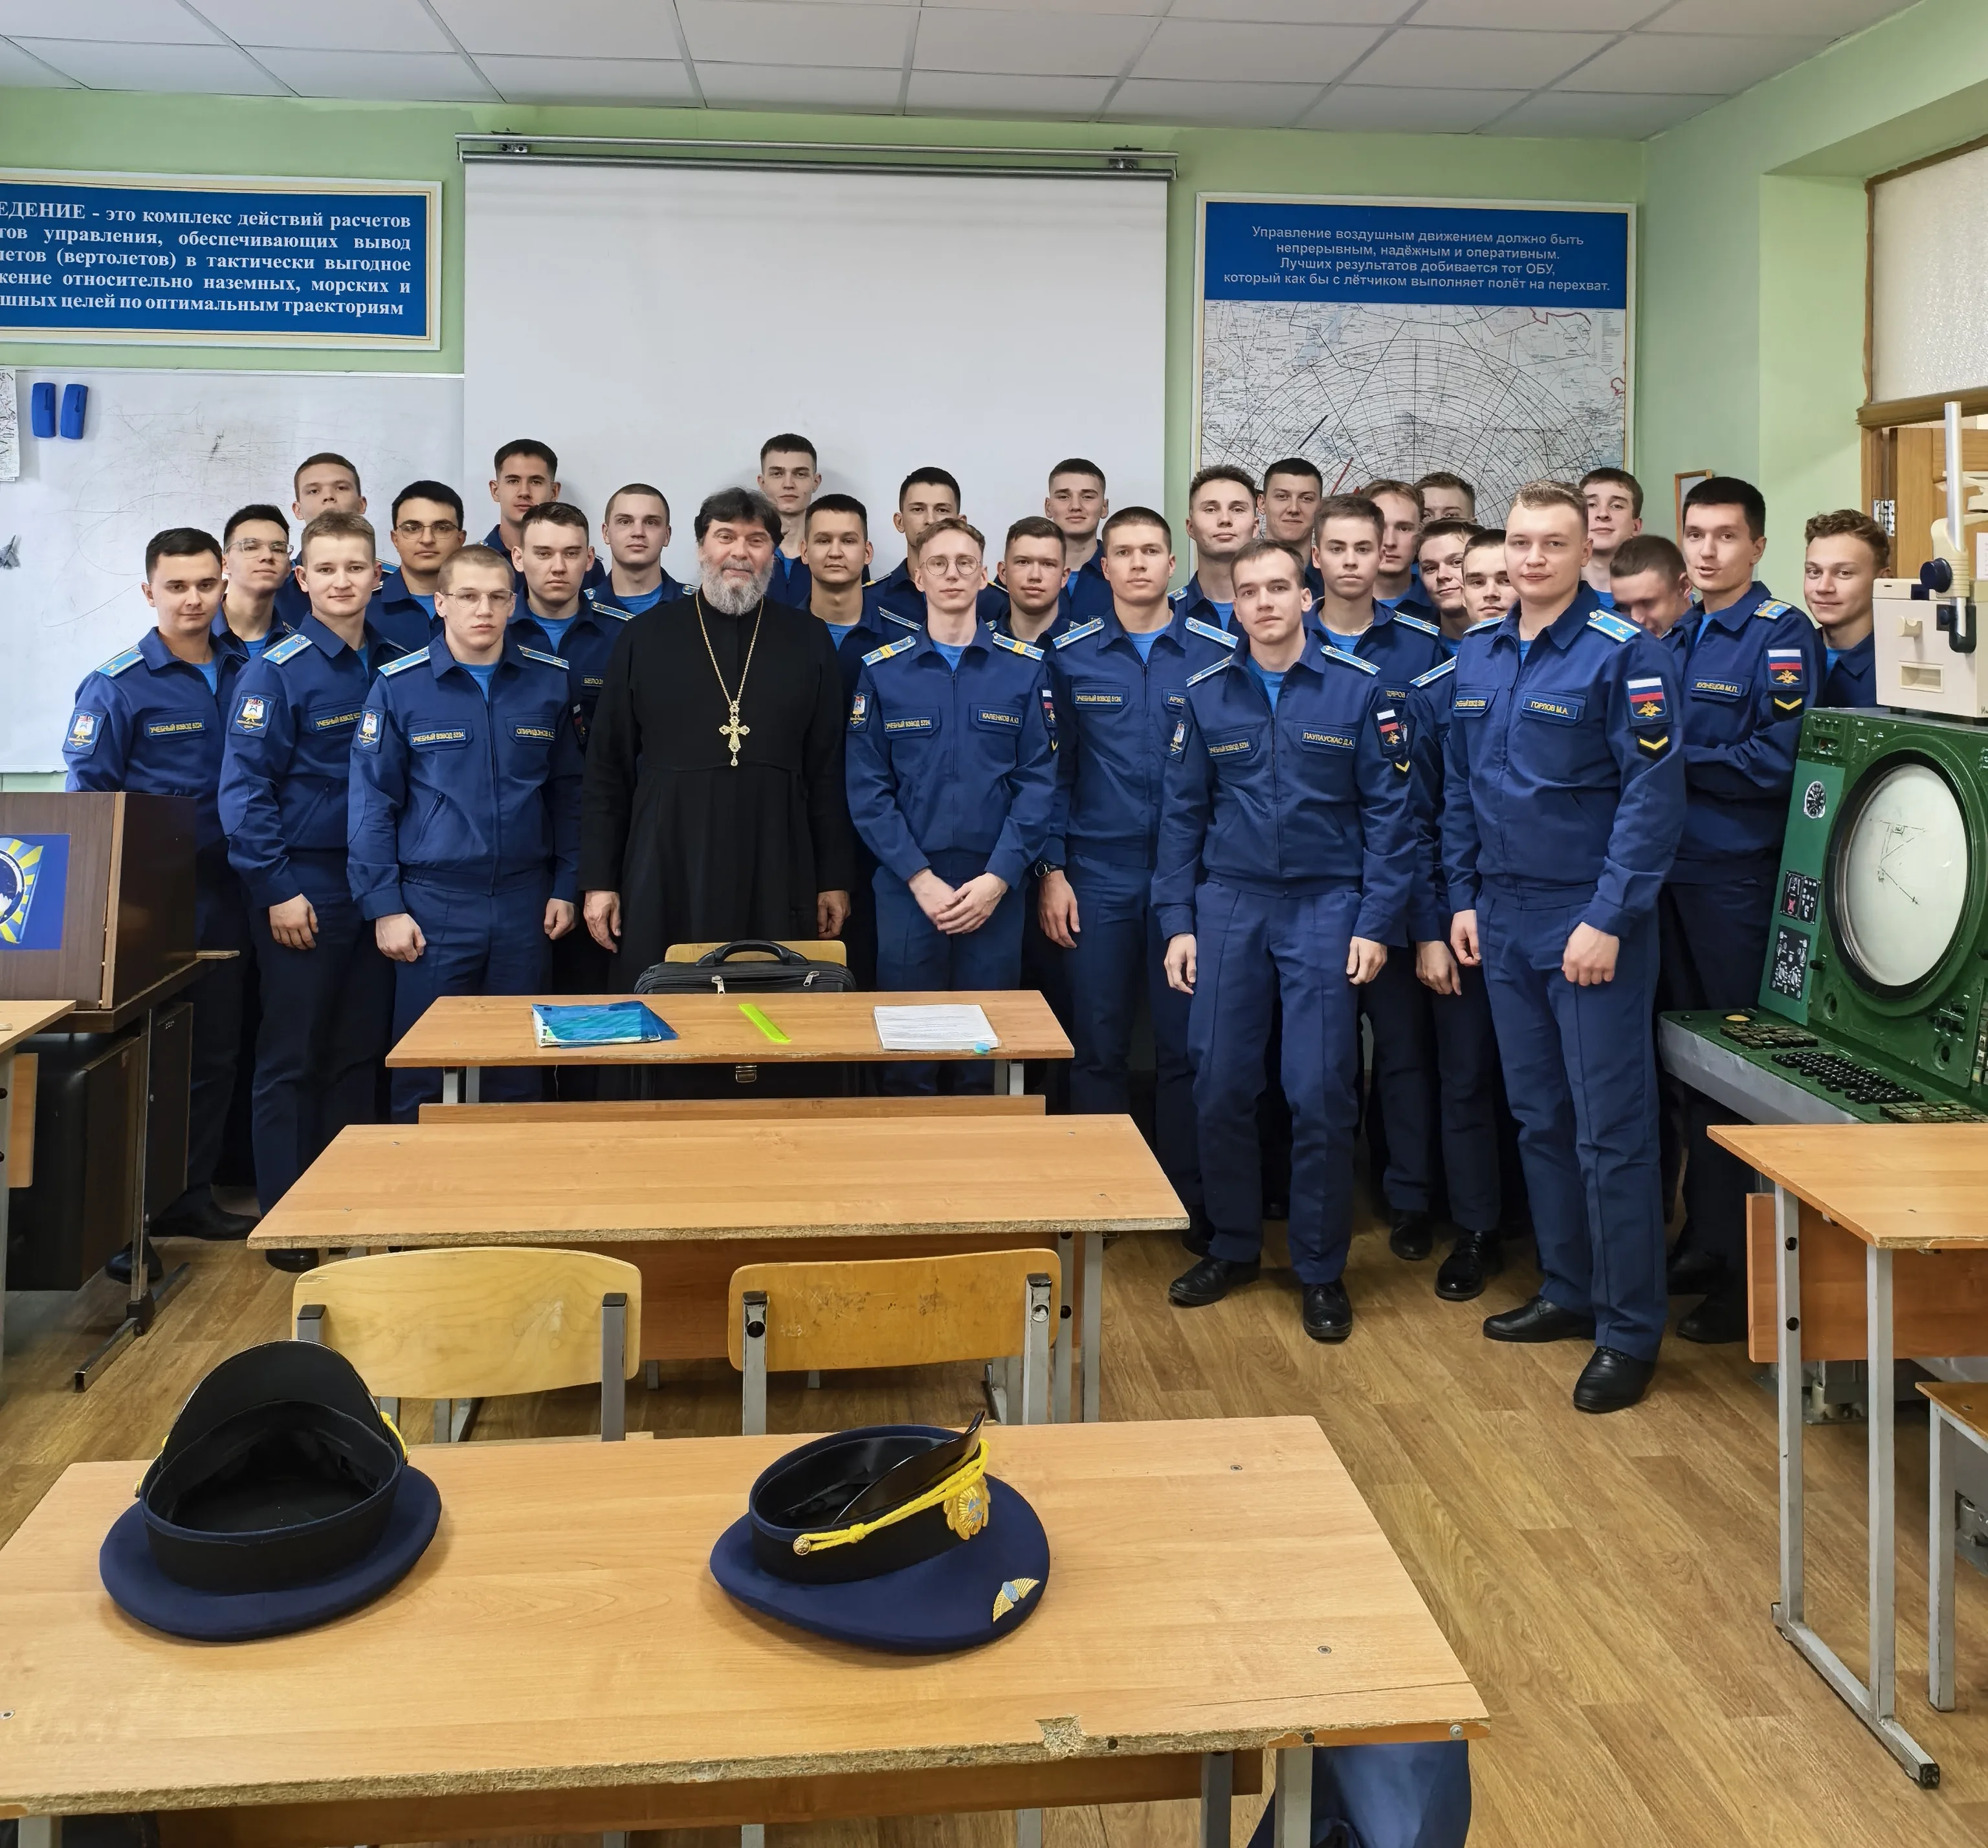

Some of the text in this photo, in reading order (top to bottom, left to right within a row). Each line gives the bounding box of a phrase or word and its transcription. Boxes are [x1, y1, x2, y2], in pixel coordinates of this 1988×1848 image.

[106, 210, 136, 222] это
[142, 211, 232, 225] комплекс
[237, 211, 323, 226] действий
[330, 215, 411, 230] расчетов
[43, 228, 163, 248] управления,
[178, 230, 338, 249] обеспечивающих
[354, 237, 411, 252] вывод
[1252, 226, 1584, 245] Управление воздушным движением должно быть
[56, 248, 176, 269] (вертолетов)
[186, 256, 196, 267] в
[206, 256, 315, 269] тактически
[325, 258, 411, 272] выгодное
[1276, 244, 1560, 260] непрерывным, надёжным и оперативным.
[1280, 258, 1555, 276] Лучших результатов добивается тот ОБУ,
[63, 274, 192, 289] относительно
[204, 278, 300, 293] наземных,
[311, 279, 389, 295] морских
[399, 281, 411, 293] и
[1224, 272, 1610, 292] который как бы с лётчиком выполняет полёт на перехват.
[61, 293, 115, 309] целей
[120, 296, 142, 309] по
[146, 297, 278, 312] оптимальным
[283, 300, 404, 317] траекториям
[1530, 701, 1556, 712] ГОРЛОВ
[1304, 732, 1343, 744] ПАУЛАУСКАС
